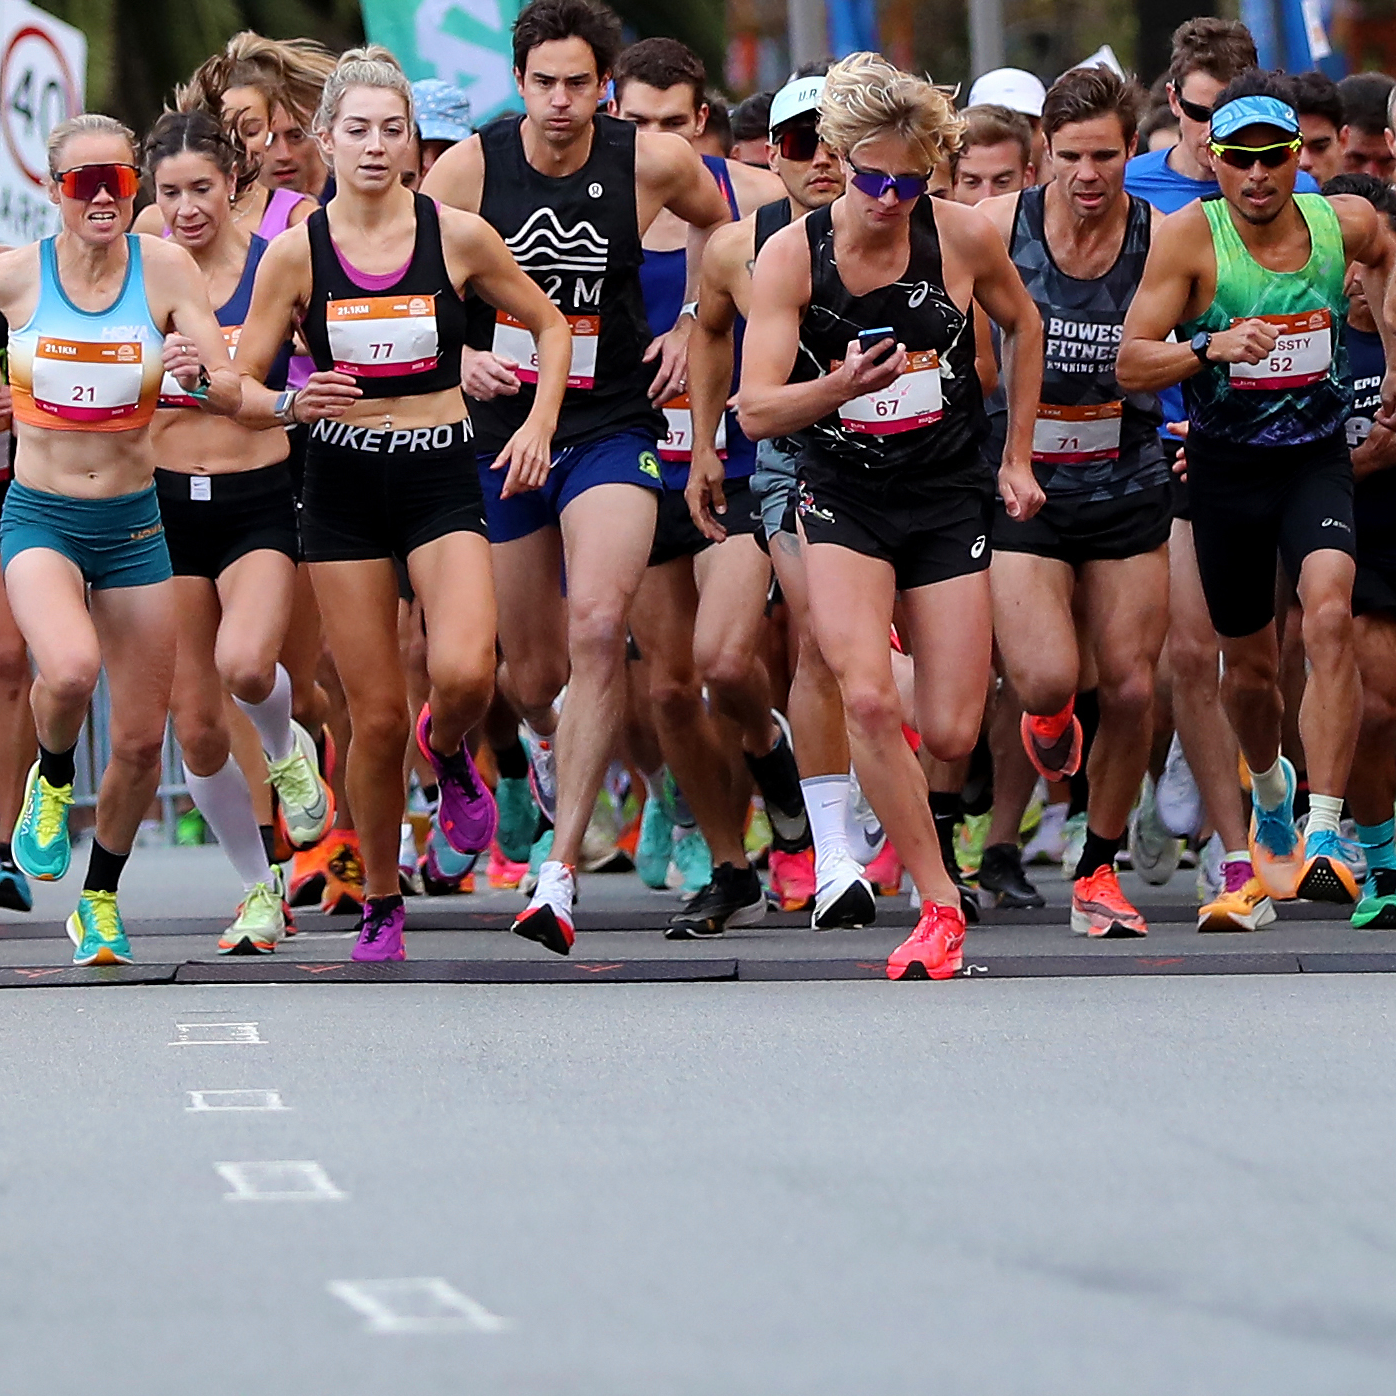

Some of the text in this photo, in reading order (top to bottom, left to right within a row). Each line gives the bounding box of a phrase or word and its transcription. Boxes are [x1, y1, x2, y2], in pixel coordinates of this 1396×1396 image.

[11, 67, 64, 145] 40
[337, 305, 370, 315] 21.1KM
[1048, 318, 1123, 342] BOWES
[44, 344, 76, 355] 21.1KM
[369, 343, 394, 359] 77
[1046, 361, 1095, 373] RUNNING
[1269, 357, 1293, 372] 52
[71, 386, 96, 402] 21
[876, 399, 899, 416] 67
[311, 418, 385, 452] NIKE
[387, 425, 453, 453] PRO
[1058, 438, 1079, 449] 71
